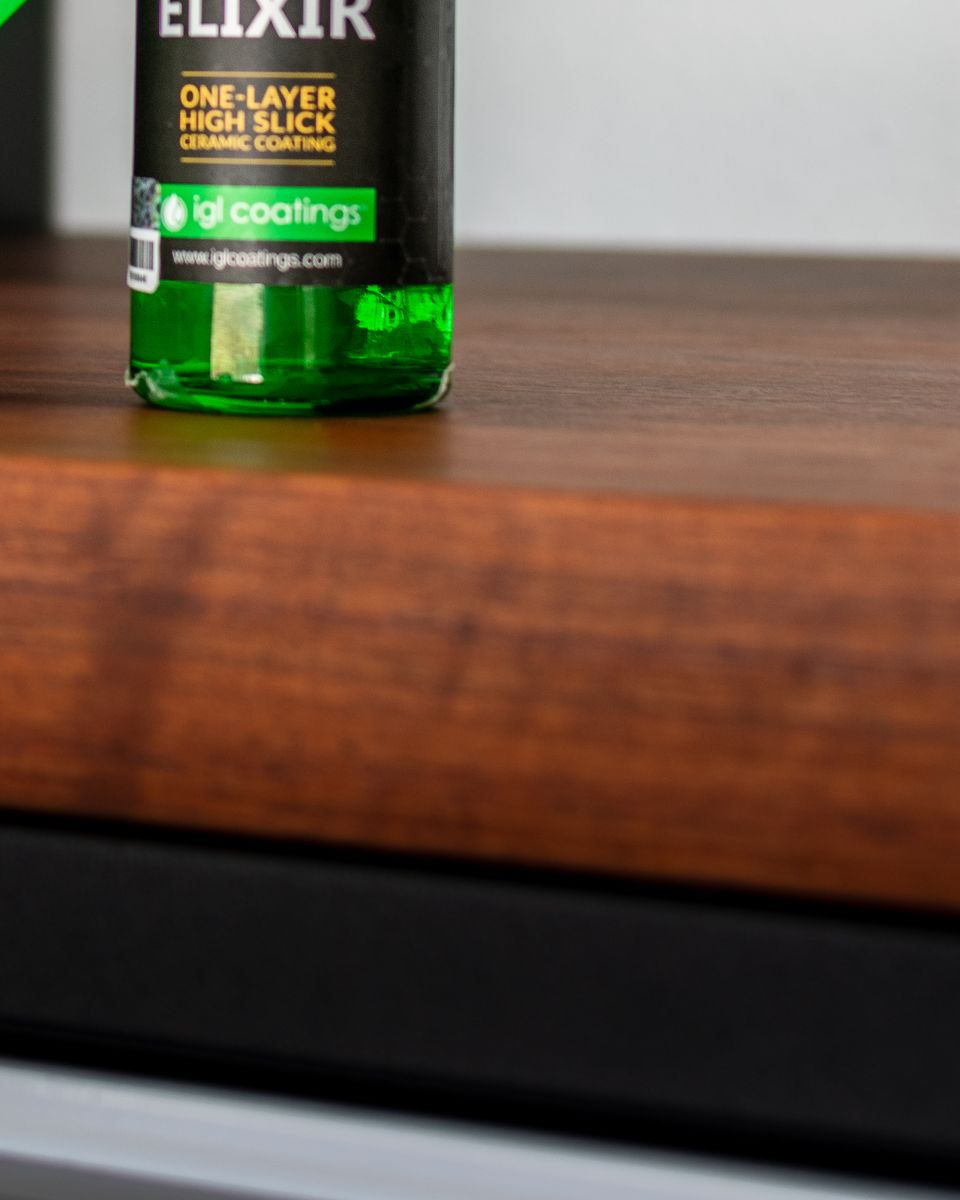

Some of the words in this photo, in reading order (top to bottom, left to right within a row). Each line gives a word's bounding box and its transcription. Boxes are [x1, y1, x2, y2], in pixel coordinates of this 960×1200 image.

[179, 84, 337, 111] ONE-LAYER
[179, 109, 246, 133] HIGH
[252, 110, 336, 135] SLICK
[179, 133, 253, 152] CERAMIC
[253, 134, 337, 153] COATING
[192, 194, 224, 230] igl
[229, 197, 362, 233] coatings
[171, 247, 343, 273] www.iglcoatings.com
